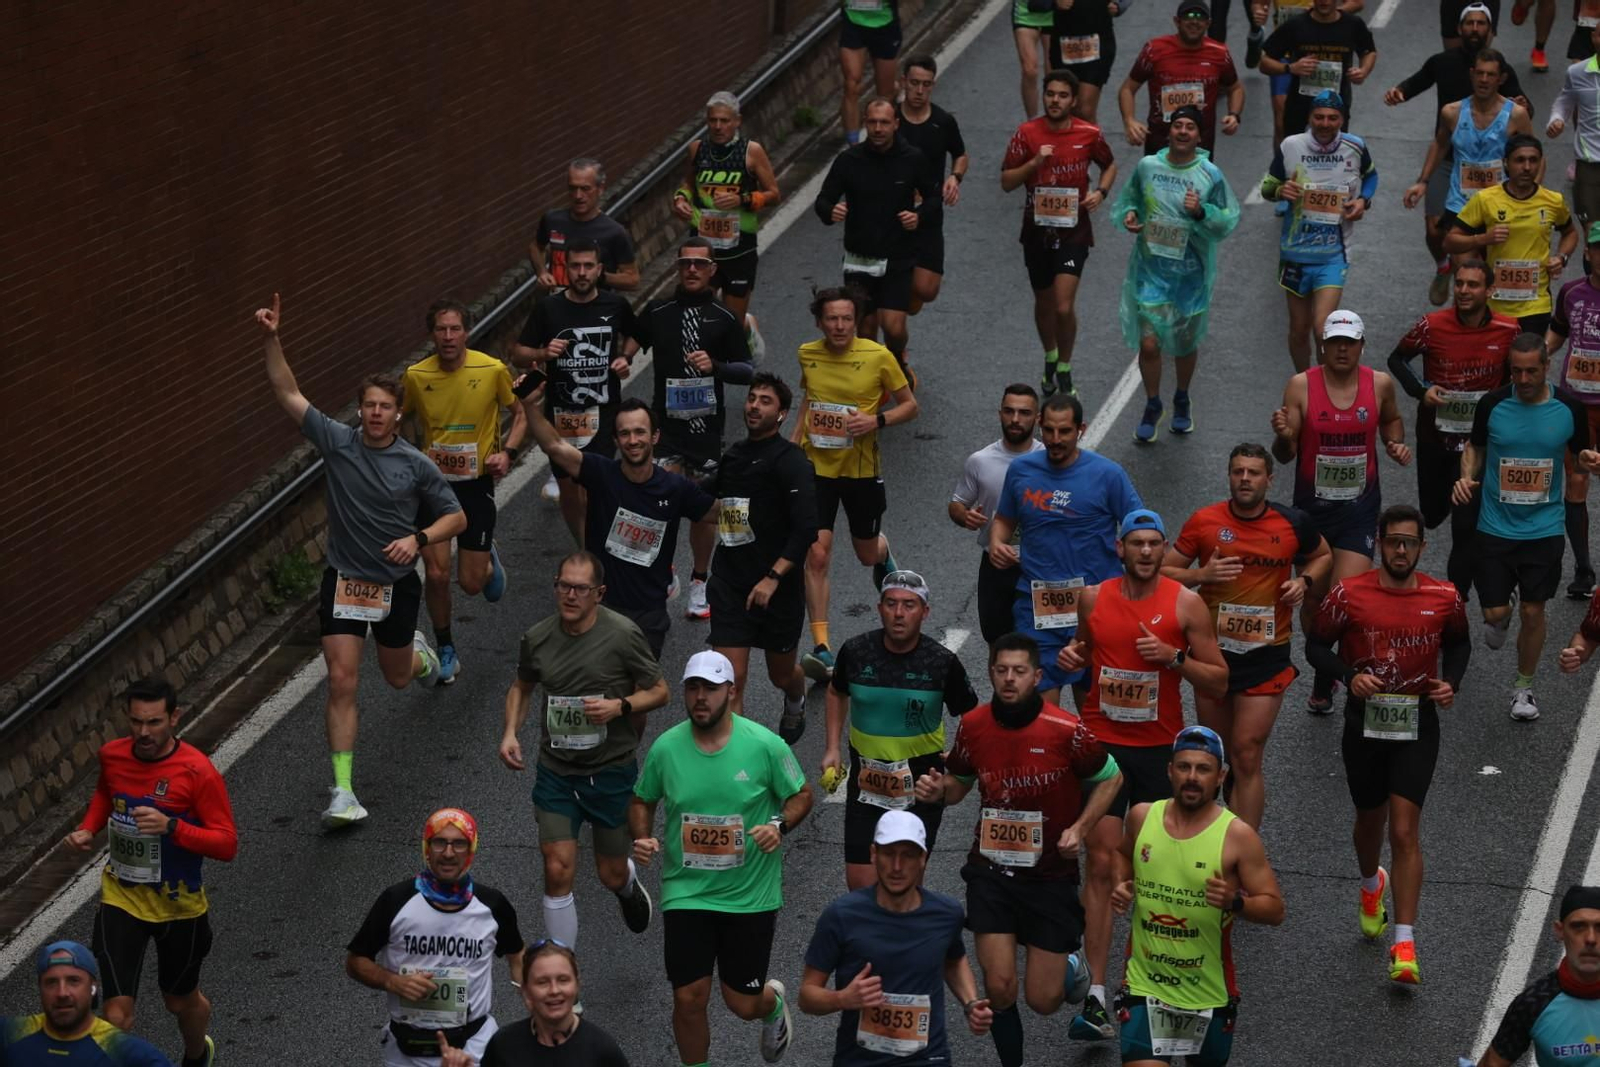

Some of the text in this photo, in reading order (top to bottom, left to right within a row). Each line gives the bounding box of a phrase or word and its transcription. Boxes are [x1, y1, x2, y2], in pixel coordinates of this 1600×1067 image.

[1168, 93, 1194, 105] 6002
[1301, 155, 1344, 163] FONTANA
[1041, 198, 1068, 210] 4134
[1309, 193, 1337, 206] 5278
[704, 219, 730, 232] 5185
[1499, 270, 1529, 283] 5153
[556, 356, 610, 367] NIGHTRUN
[674, 391, 704, 404] 1910
[813, 413, 842, 429] 5495
[435, 456, 465, 468] 5499
[1324, 466, 1355, 480] 7758
[1508, 470, 1540, 484] 5207
[1053, 490, 1071, 499] ONE
[1051, 498, 1071, 506] DAY
[616, 521, 654, 545] 17979
[345, 582, 379, 600] 6042
[1042, 592, 1074, 607] 5698
[1227, 617, 1261, 633] 5764
[1107, 682, 1144, 701] 4147
[1373, 706, 1408, 724] 7034
[866, 773, 899, 790] 4072
[691, 828, 729, 846] 6225
[990, 824, 1027, 842] 5206
[1176, 898, 1208, 908] REAL
[404, 935, 484, 959] TAGAMOCHIS
[871, 1007, 914, 1029] 3853
[1552, 1043, 1590, 1057] BETTA
